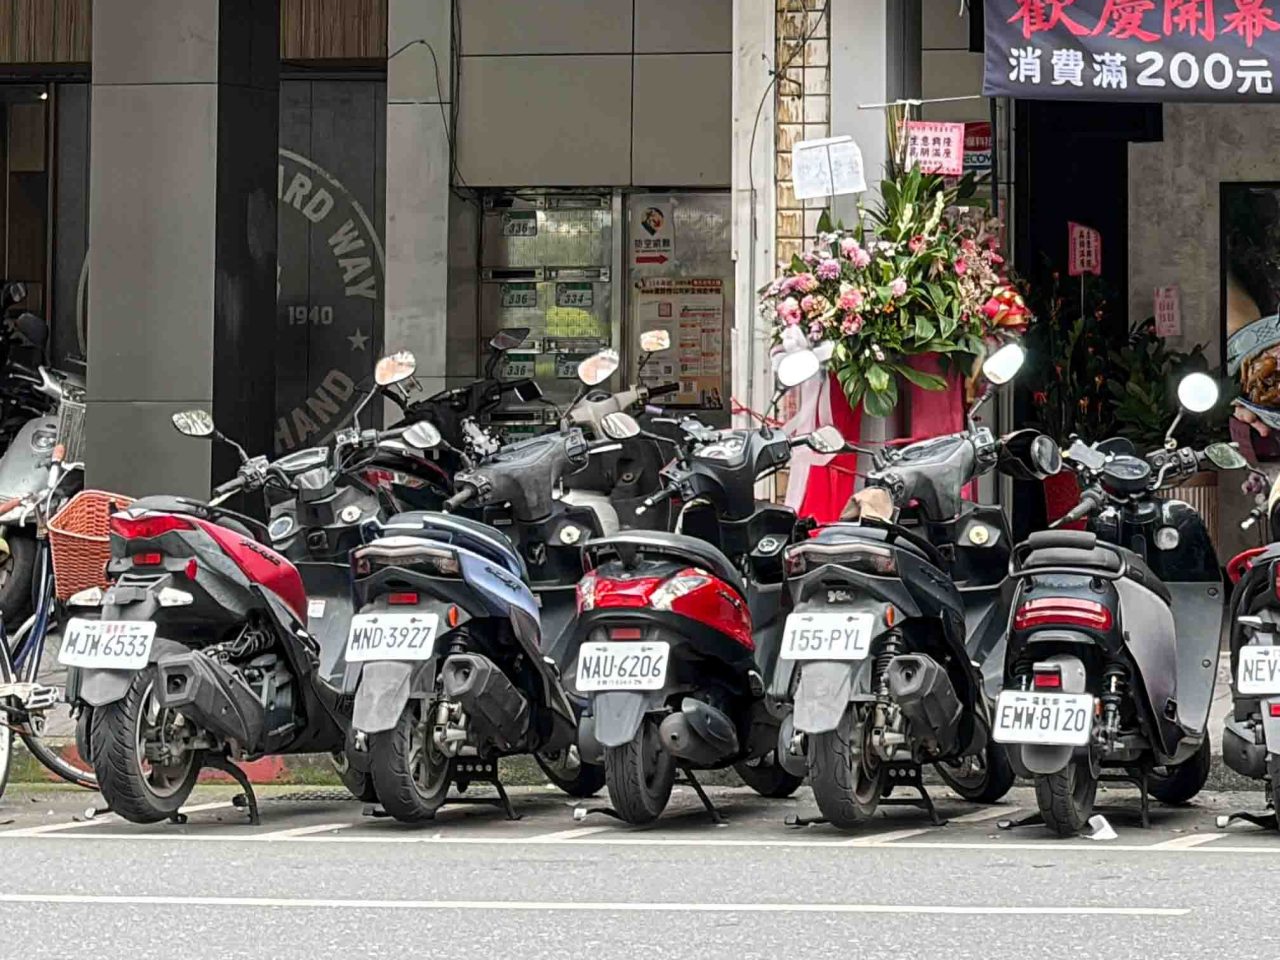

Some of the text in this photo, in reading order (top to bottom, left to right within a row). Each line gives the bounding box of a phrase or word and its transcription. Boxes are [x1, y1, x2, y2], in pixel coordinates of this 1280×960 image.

[1008, 48, 1274, 96] 消費滿200元
[328, 218, 377, 301] WAY
[288, 306, 333, 325] 1940
[274, 368, 354, 452] HAND
